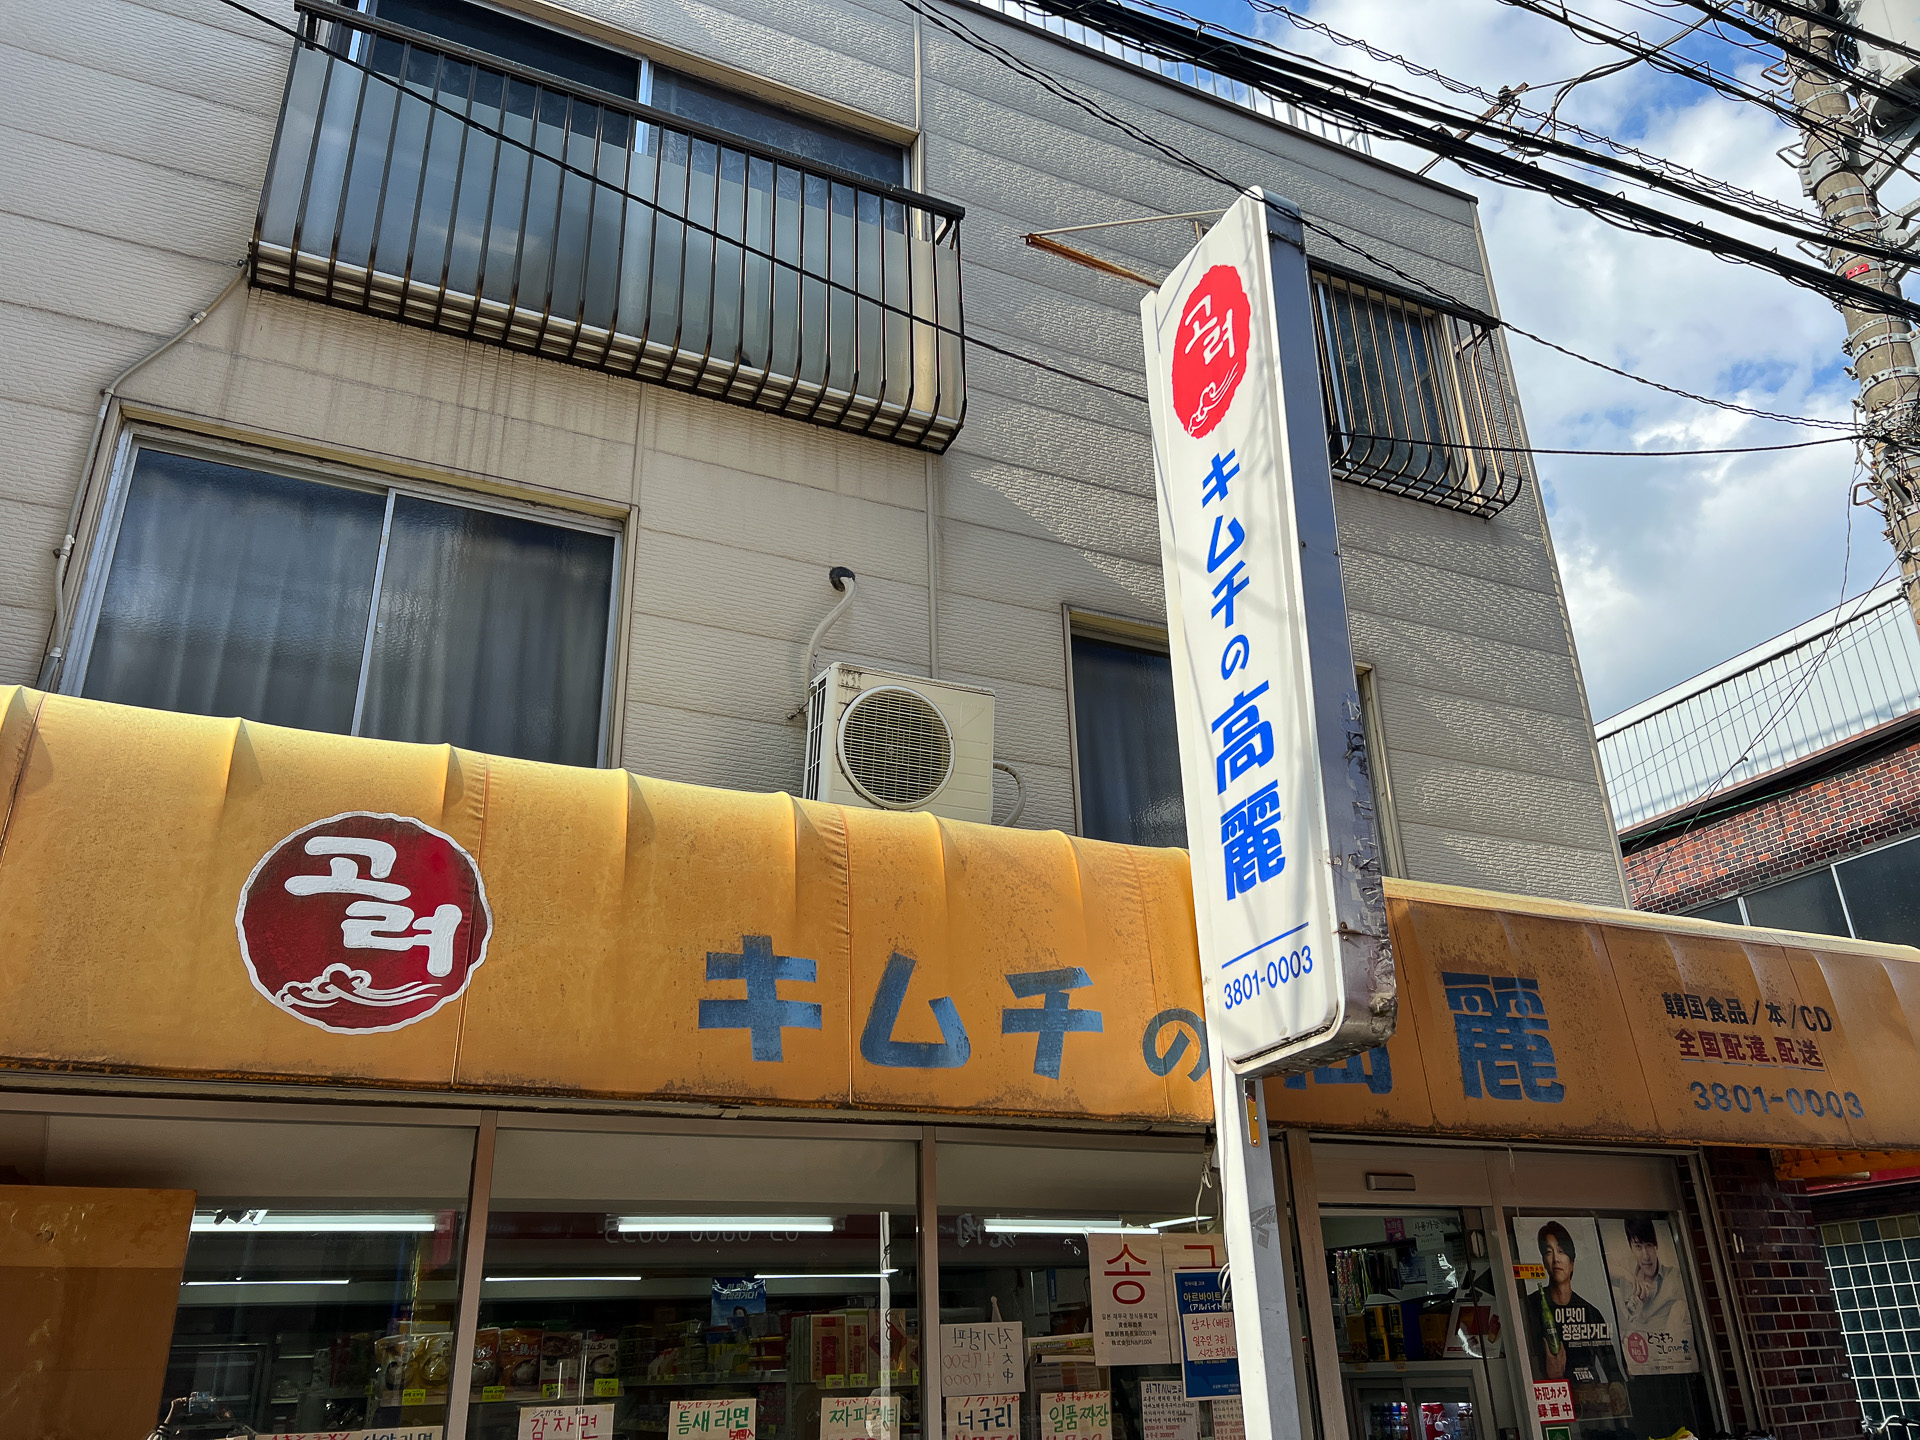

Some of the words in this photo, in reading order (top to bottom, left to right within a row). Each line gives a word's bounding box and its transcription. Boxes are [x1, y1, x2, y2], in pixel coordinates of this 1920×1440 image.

[1185, 294, 1235, 365] 고려
[1202, 448, 1286, 901] キムチの高麗
[284, 836, 463, 977] 고려
[1223, 945, 1313, 1010] 3801-0003
[698, 935, 1566, 1103] キムチの麗
[1690, 1081, 1864, 1119] 3801-0003
[957, 1404, 1012, 1431] 너구리
[1534, 1386, 1567, 1401] 防犯カメラ
[1537, 1402, 1572, 1418] 録画中
[530, 1414, 598, 1440] 감자면
